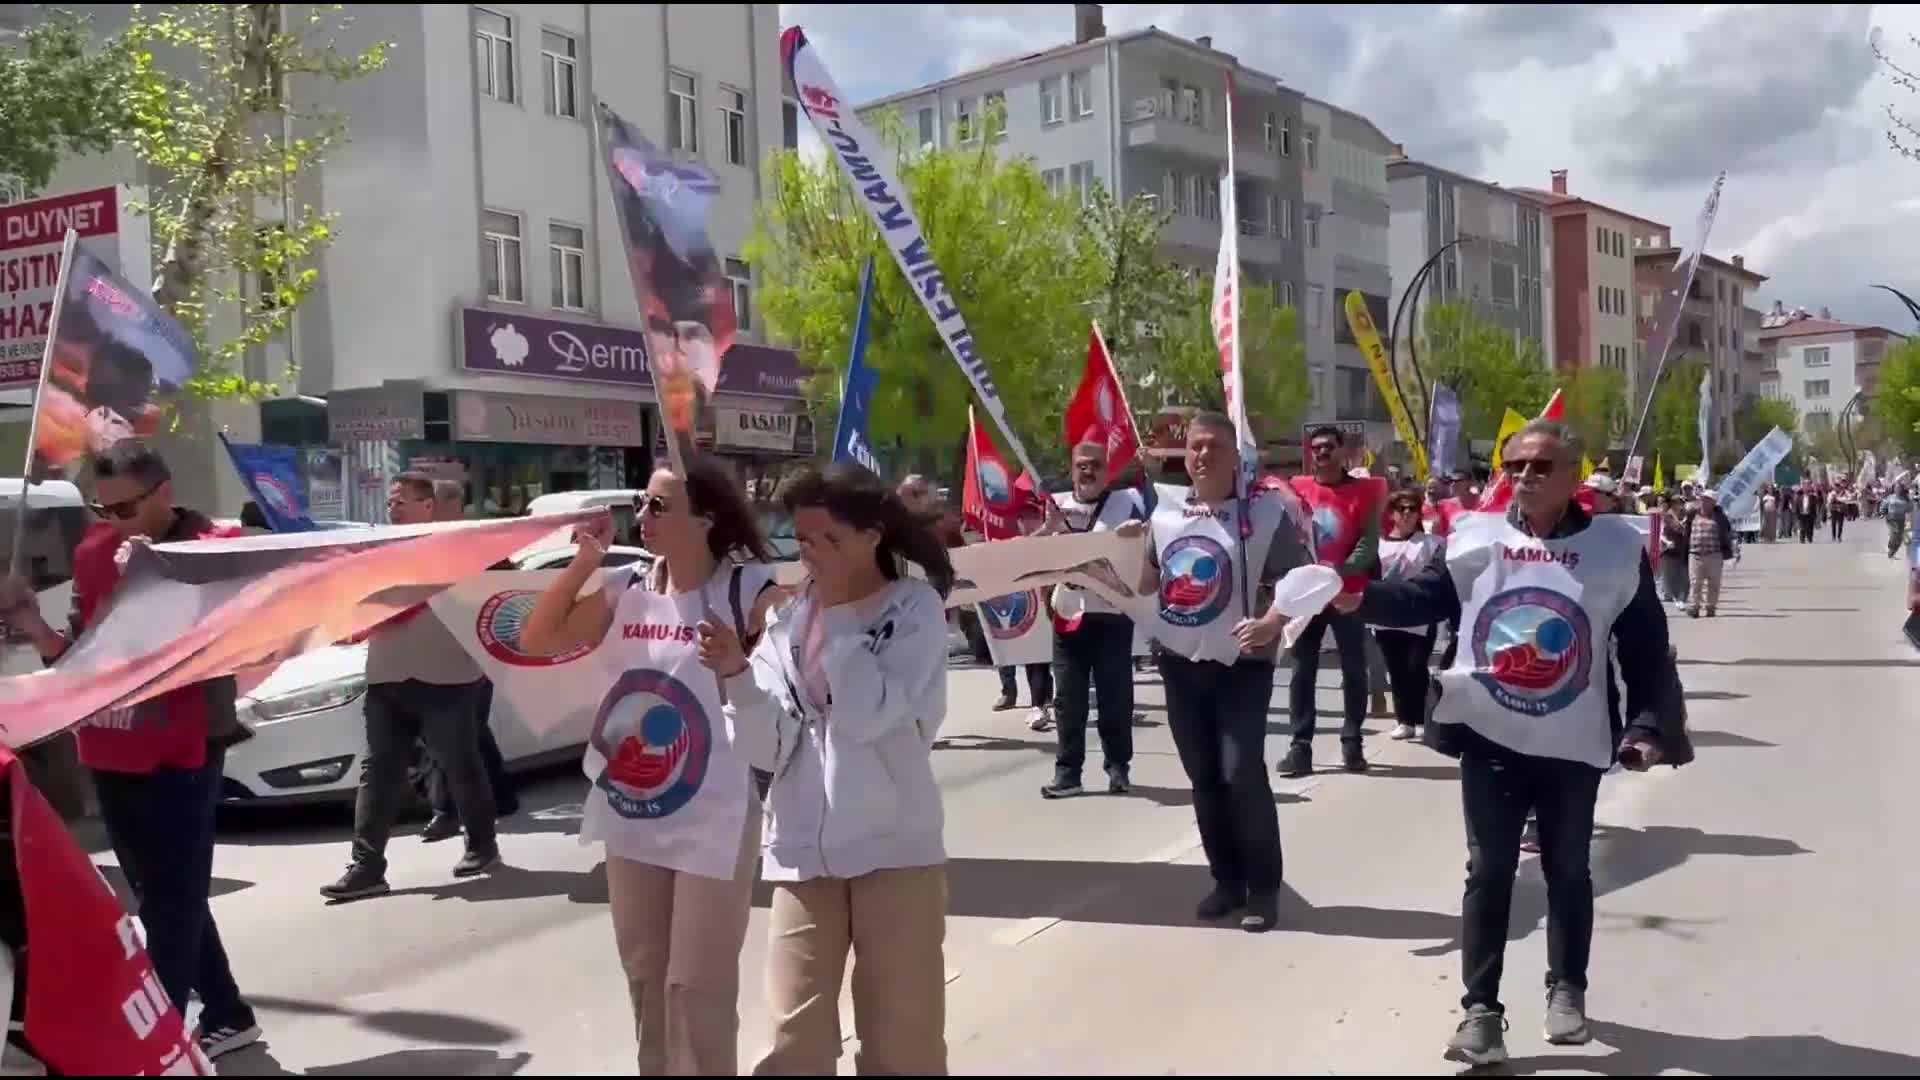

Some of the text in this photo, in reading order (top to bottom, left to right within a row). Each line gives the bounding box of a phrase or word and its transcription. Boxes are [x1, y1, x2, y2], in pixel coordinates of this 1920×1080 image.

[6, 200, 105, 241] DUYNET
[547, 329, 651, 372] Derm
[622, 620, 695, 646] KAMU-İŞ
